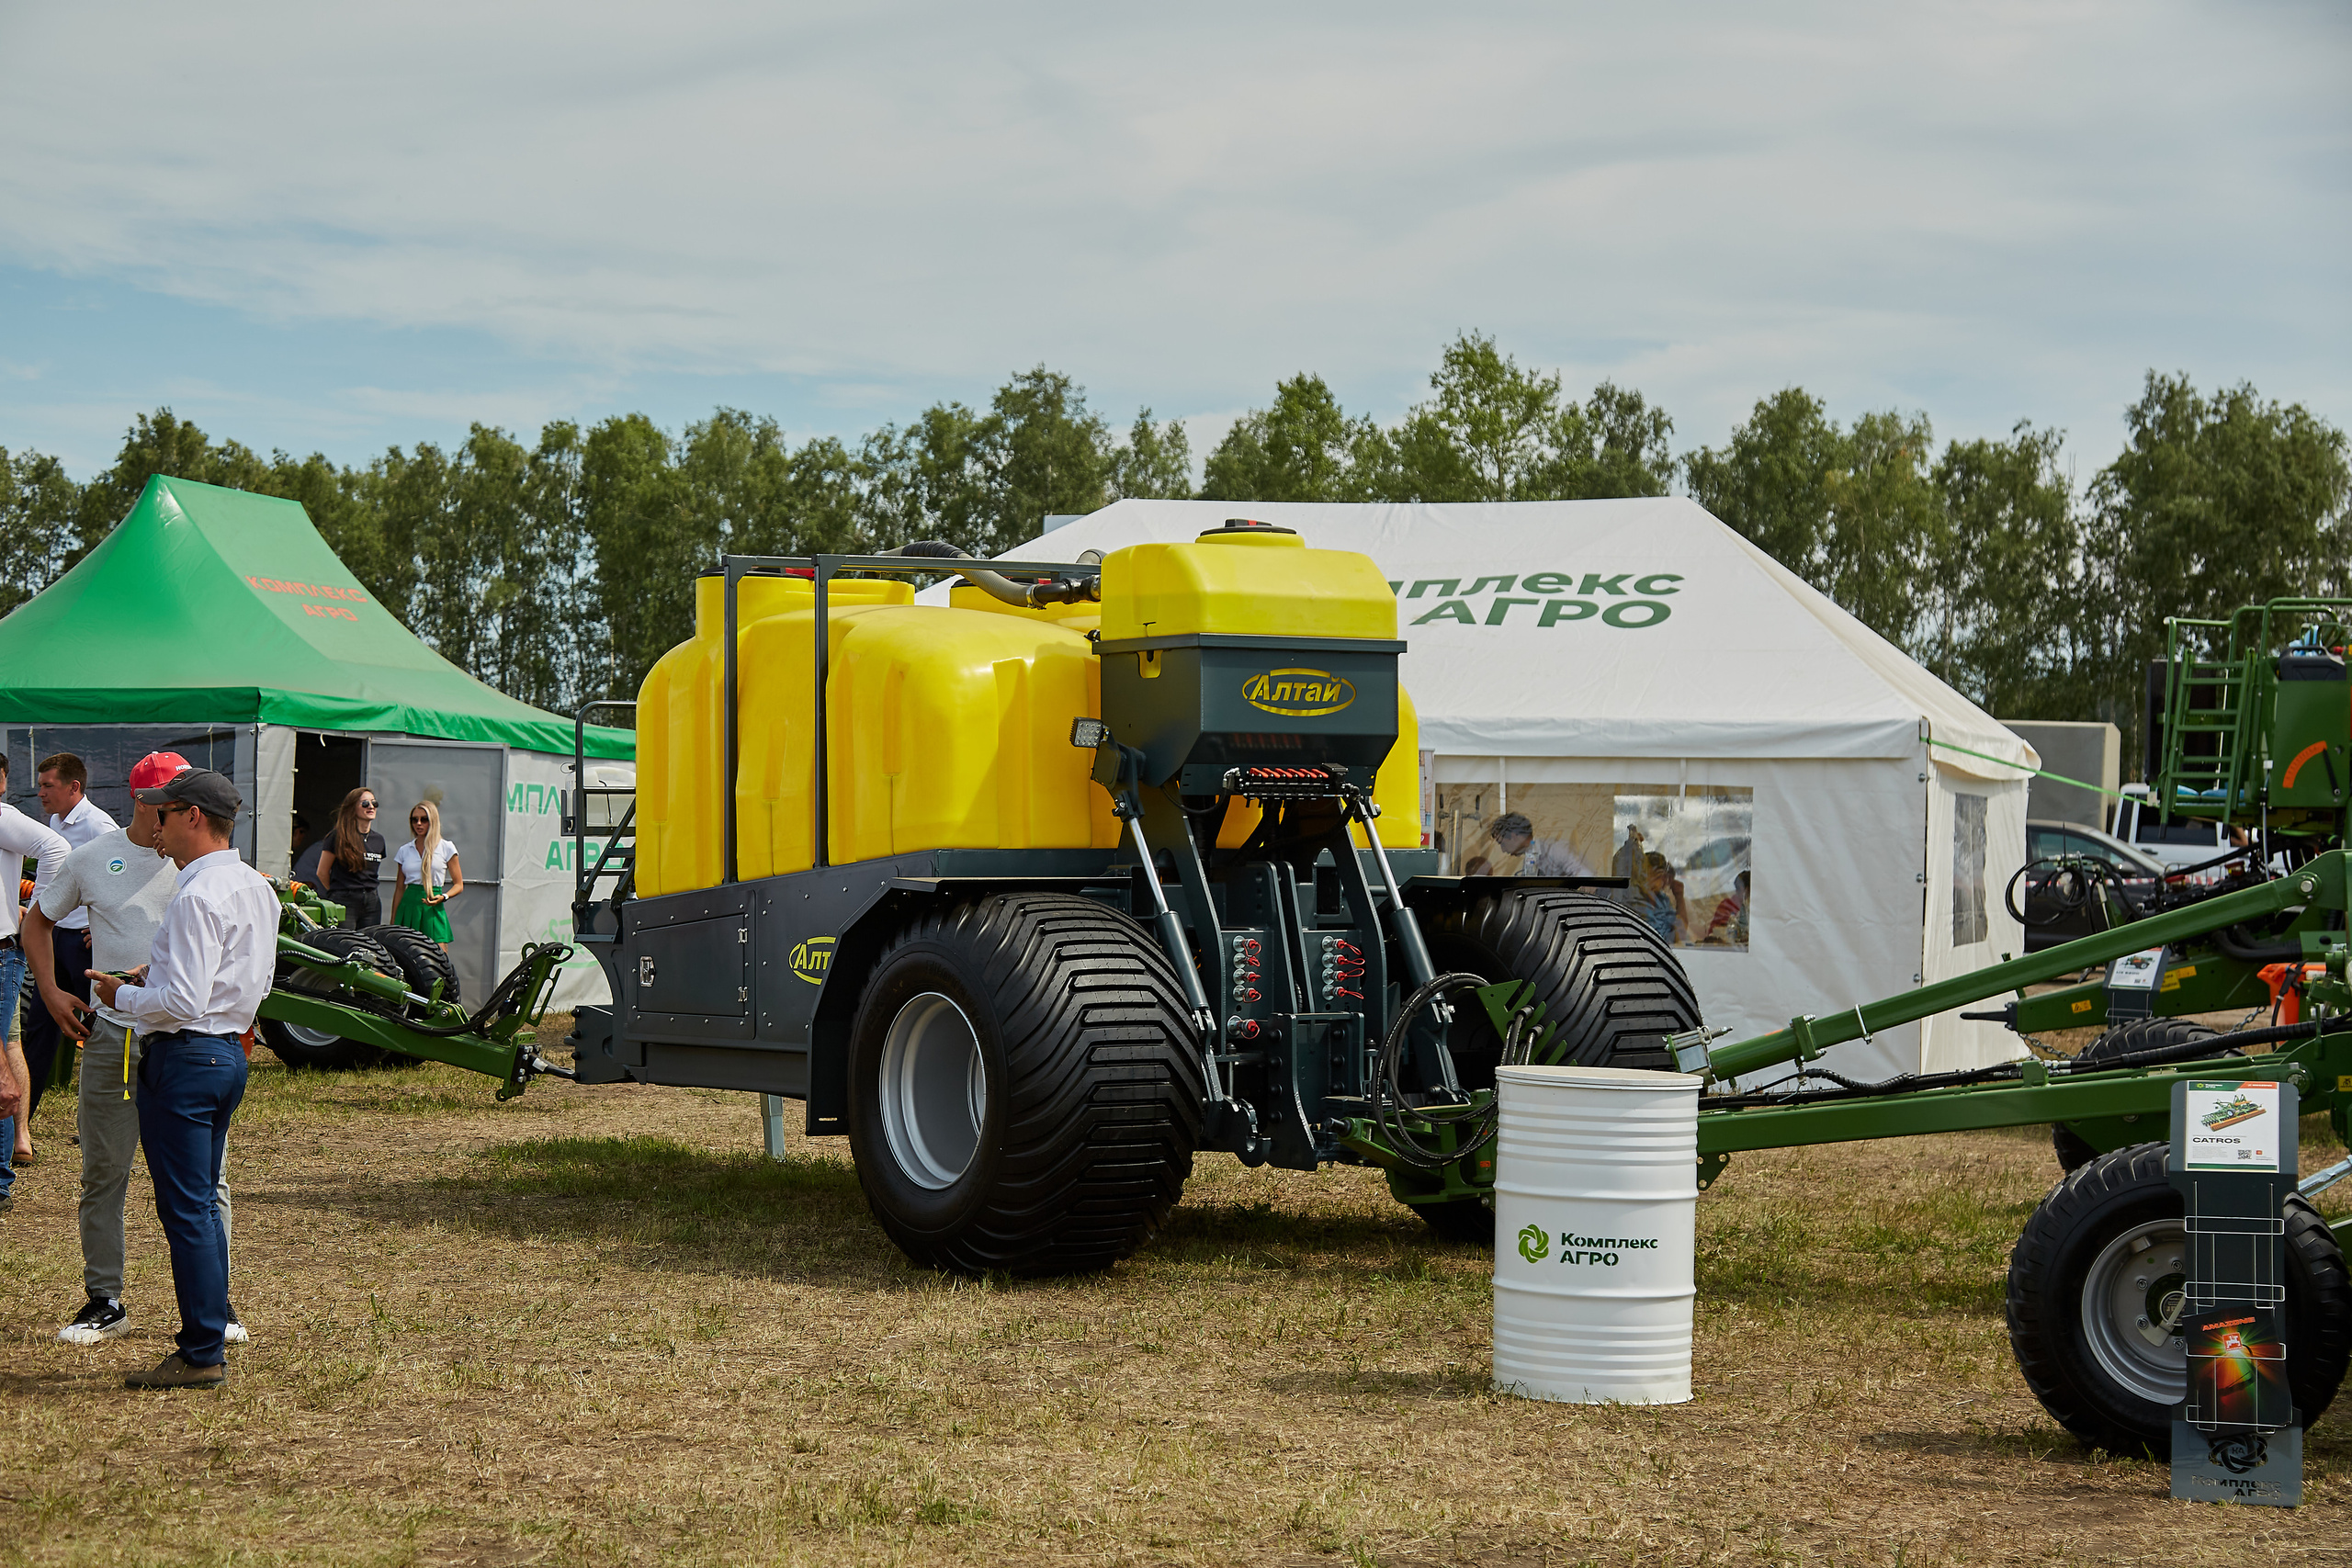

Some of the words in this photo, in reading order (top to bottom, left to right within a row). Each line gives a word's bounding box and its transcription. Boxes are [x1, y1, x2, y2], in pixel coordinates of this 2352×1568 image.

[245, 575, 368, 603] КОМПЛЕКС
[301, 604, 359, 622] АГРО
[1408, 597, 1671, 628] АГРО
[1249, 674, 1342, 702] Алтай
[1561, 1232, 1658, 1249] Комплекс
[1559, 1250, 1620, 1267] АГРО
[2202, 1316, 2256, 1332] AMAZONE
[2191, 1475, 2282, 1490] Комплекс
